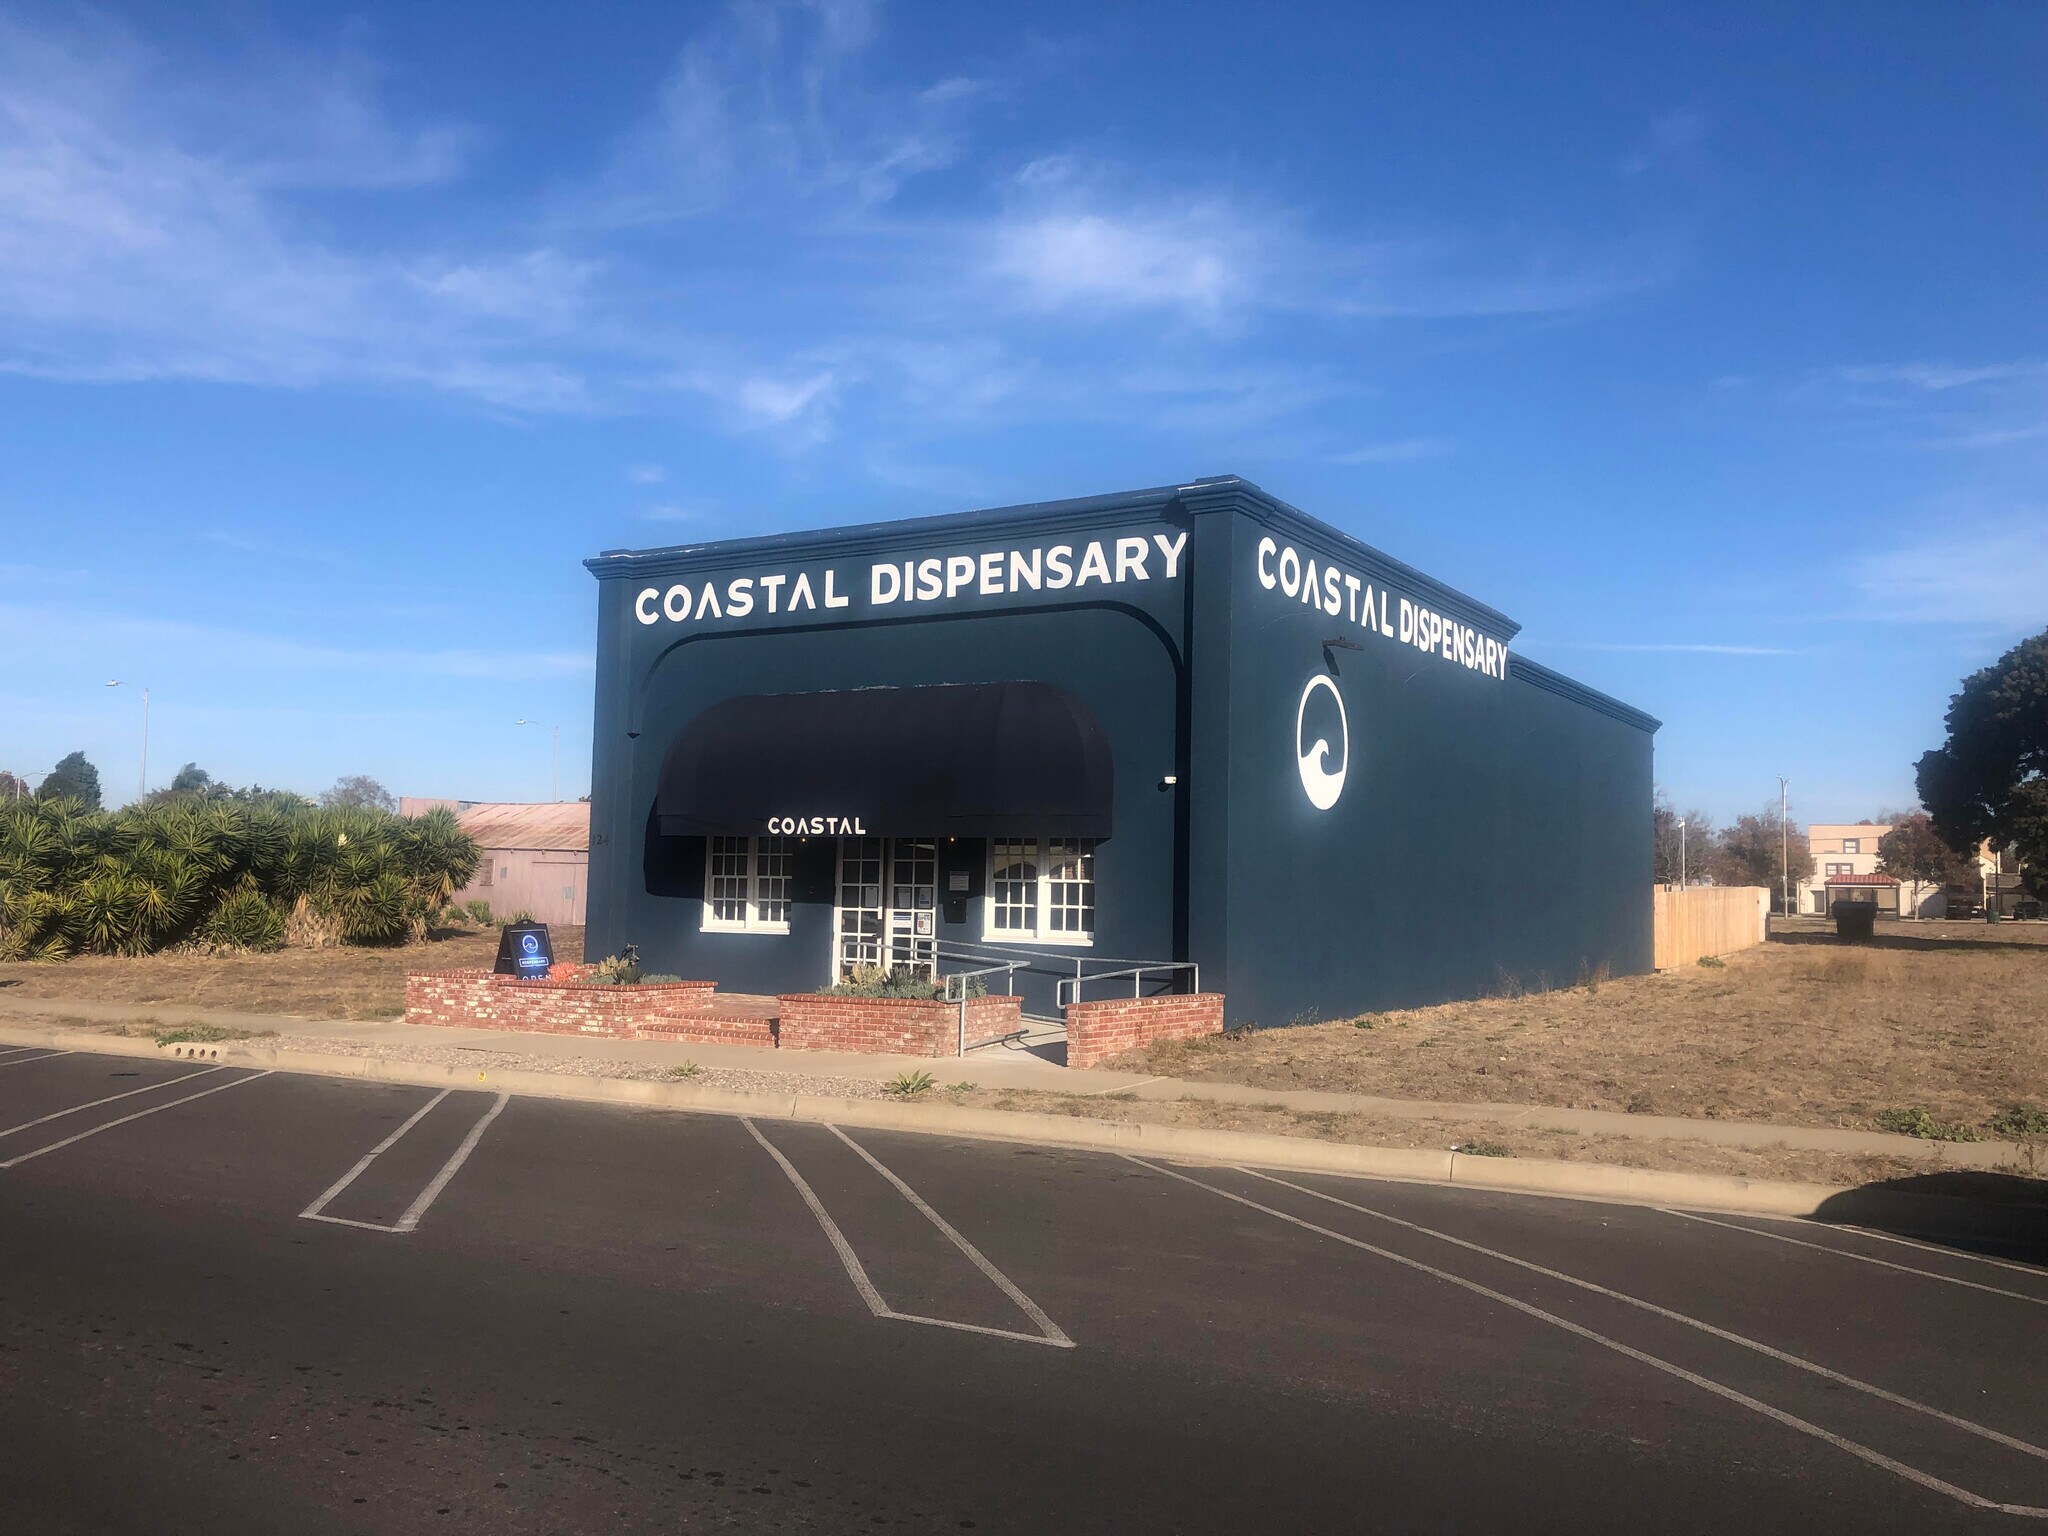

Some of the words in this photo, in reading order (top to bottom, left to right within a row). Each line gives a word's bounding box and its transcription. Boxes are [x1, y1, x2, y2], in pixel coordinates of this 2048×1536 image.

[635, 569, 849, 625] COASTAL
[871, 532, 1187, 605] DISPENSARY
[1257, 536, 1394, 638] COASTAL
[1399, 597, 1508, 681] DISPENSARY
[767, 816, 866, 835] COASTAL
